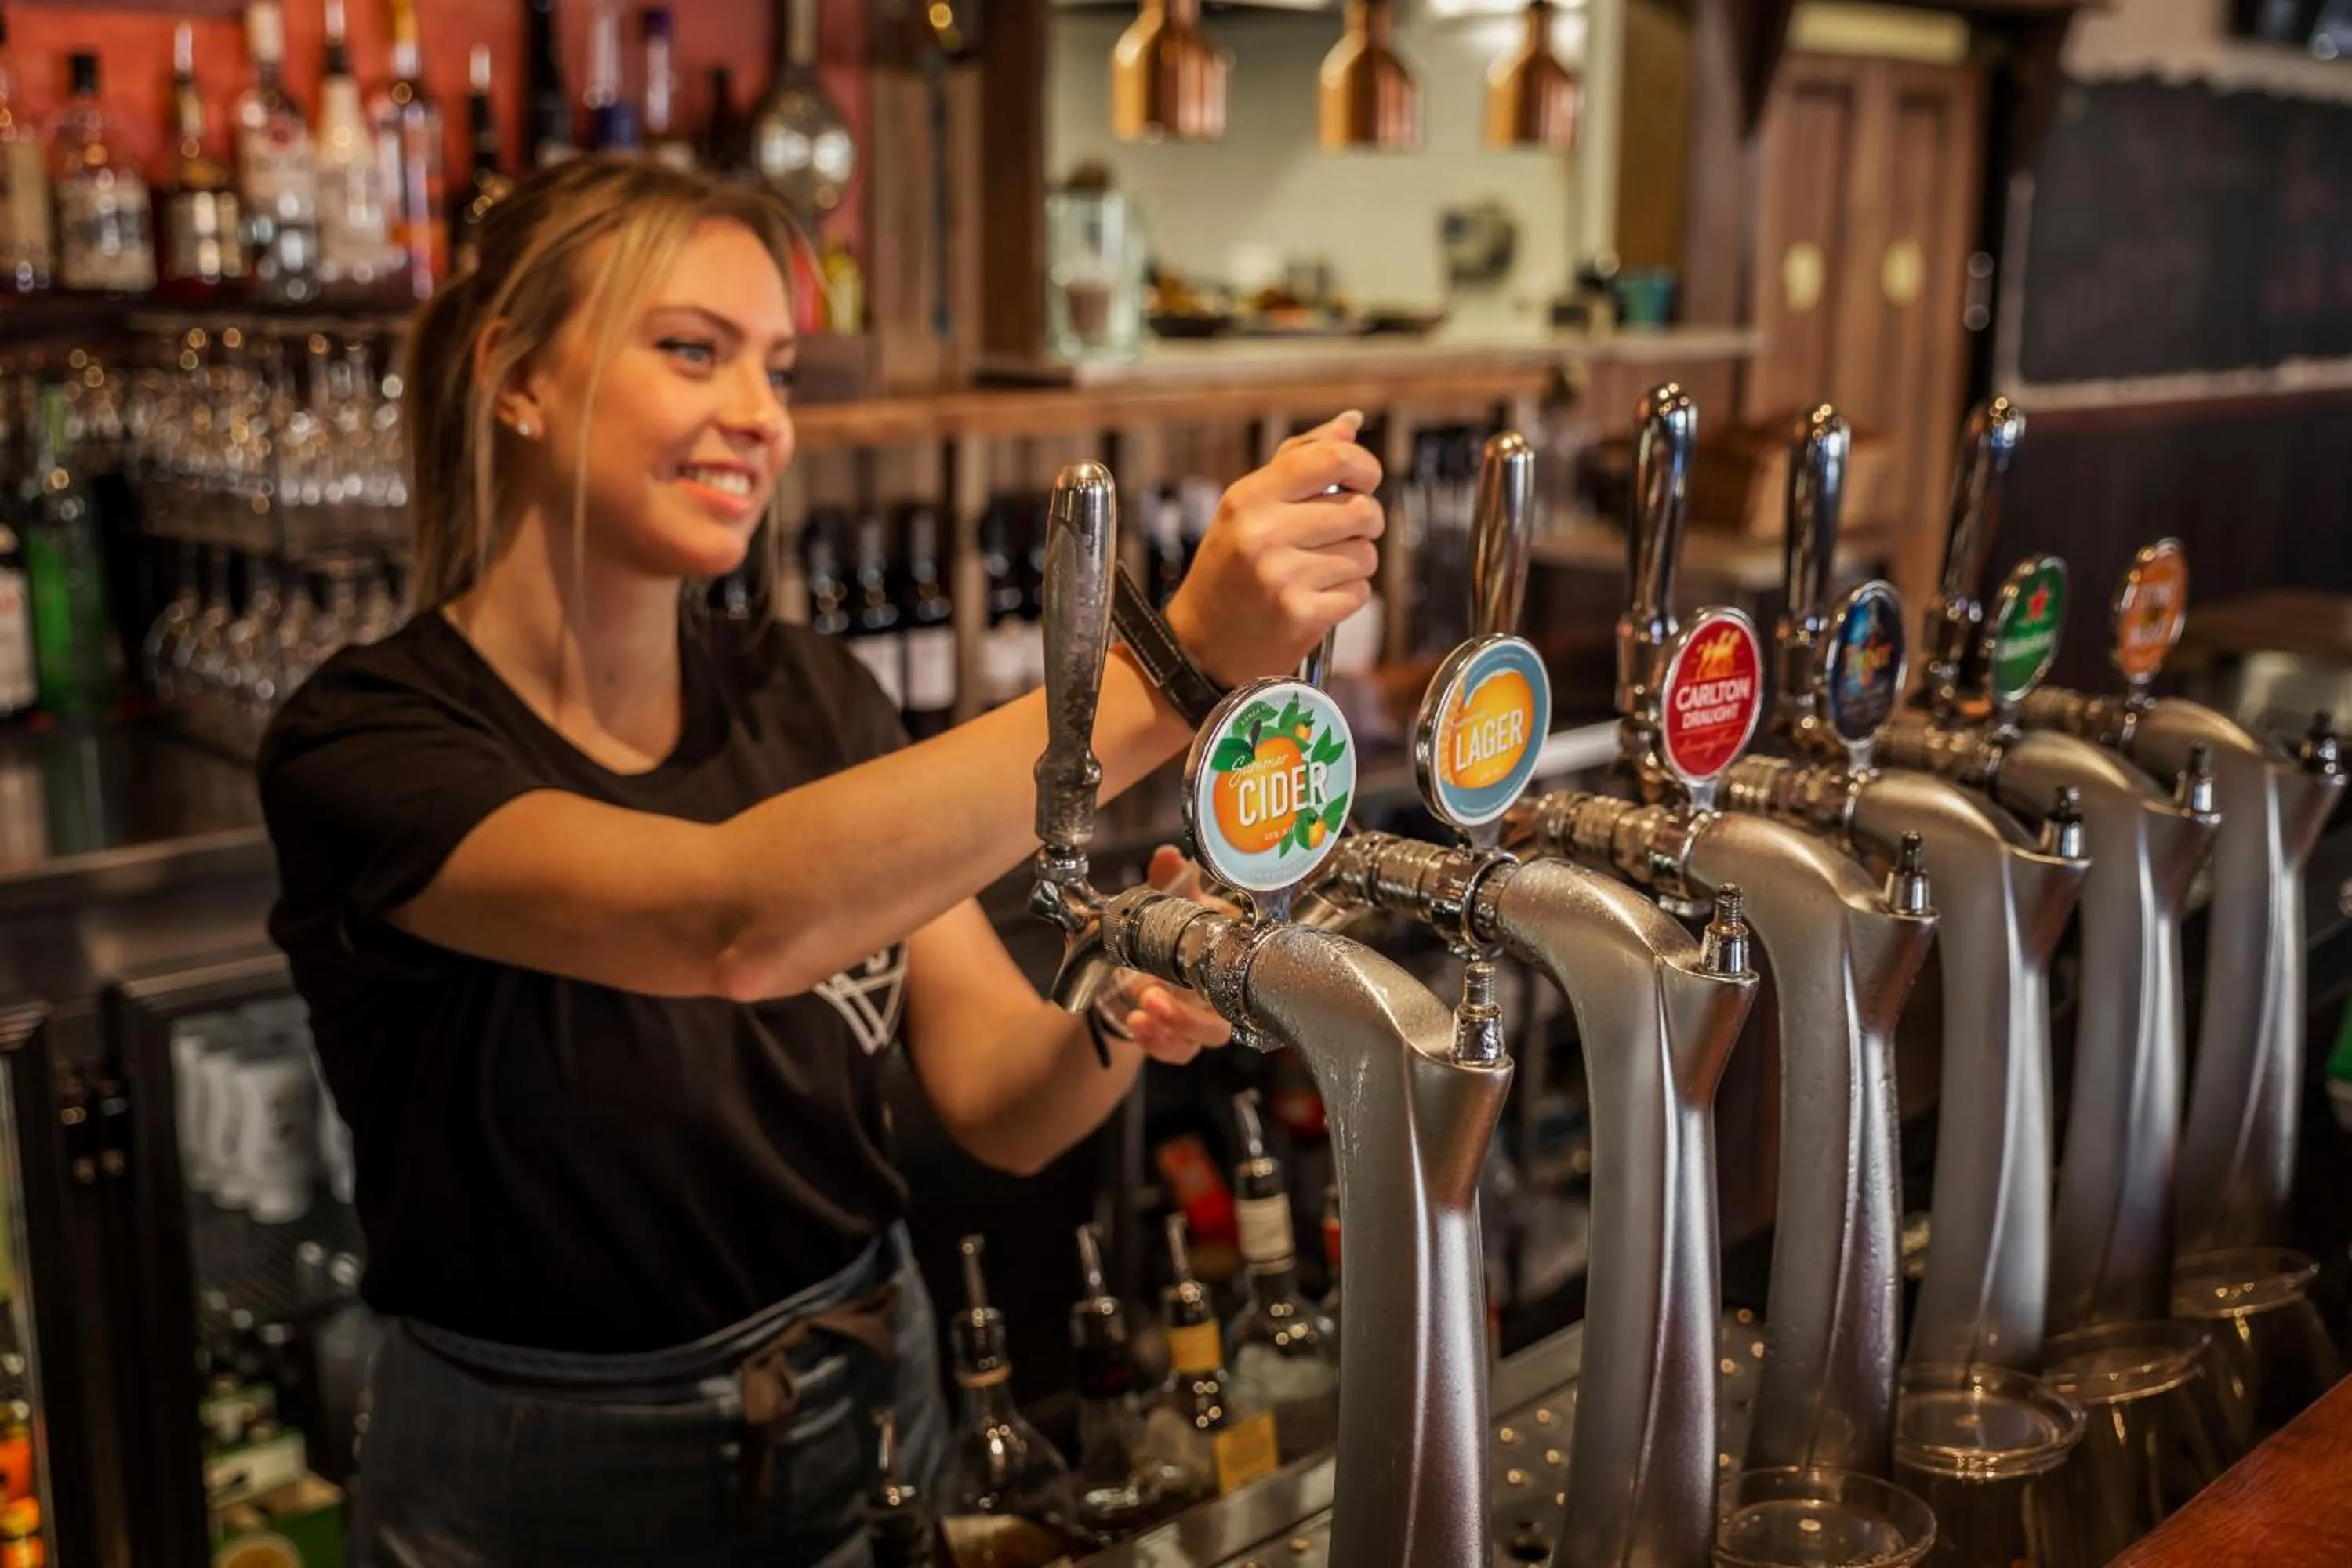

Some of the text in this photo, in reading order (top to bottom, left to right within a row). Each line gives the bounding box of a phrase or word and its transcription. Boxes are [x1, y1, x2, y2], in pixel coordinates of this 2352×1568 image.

[1675, 676, 1752, 712] CARLTON
[1455, 708, 1524, 771] LAGER
[1238, 760, 1330, 827] CIDER
